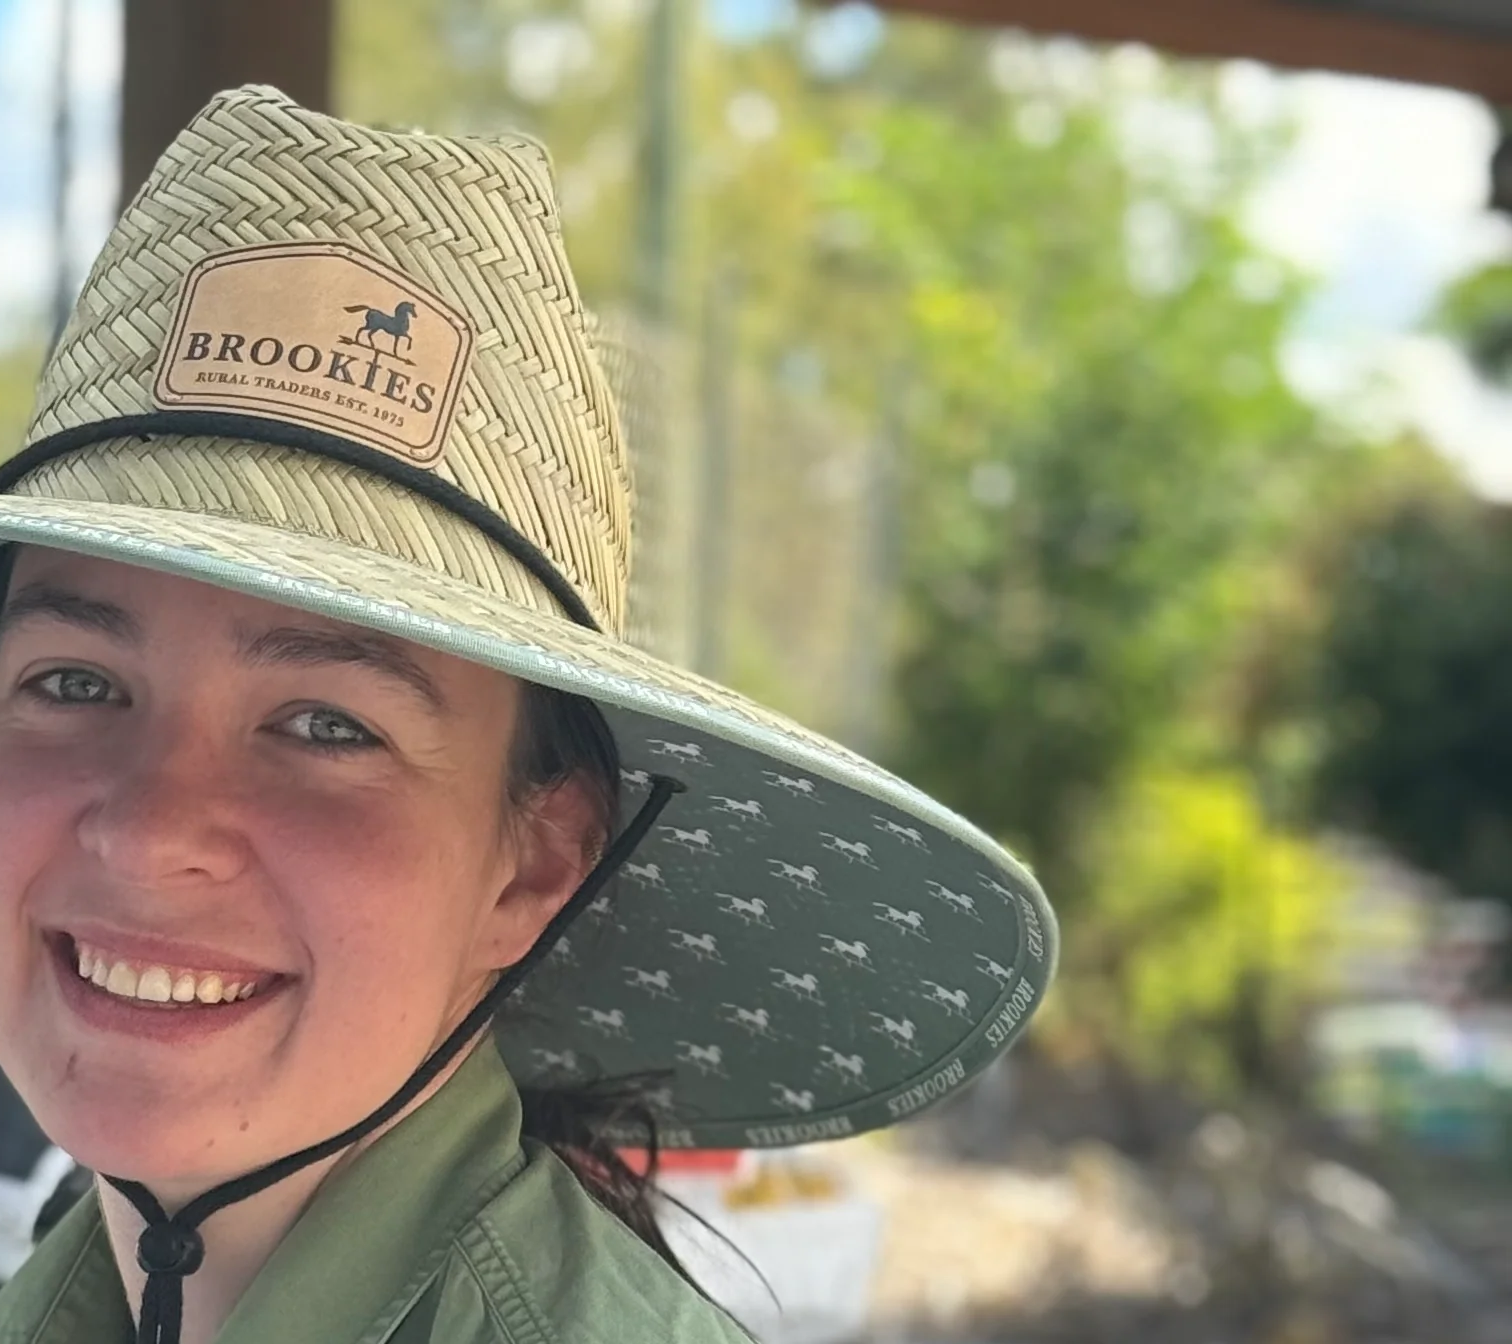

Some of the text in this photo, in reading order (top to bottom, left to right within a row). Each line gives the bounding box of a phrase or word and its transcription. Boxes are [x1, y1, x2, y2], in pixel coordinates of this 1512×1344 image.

[182, 331, 437, 415] BROOKIES
[194, 371, 250, 387] RURAL
[254, 376, 331, 402] TRADERS
[335, 393, 370, 415] EST.
[889, 1058, 967, 1117] BROOKIES
[745, 1116, 854, 1147] BROOKIES
